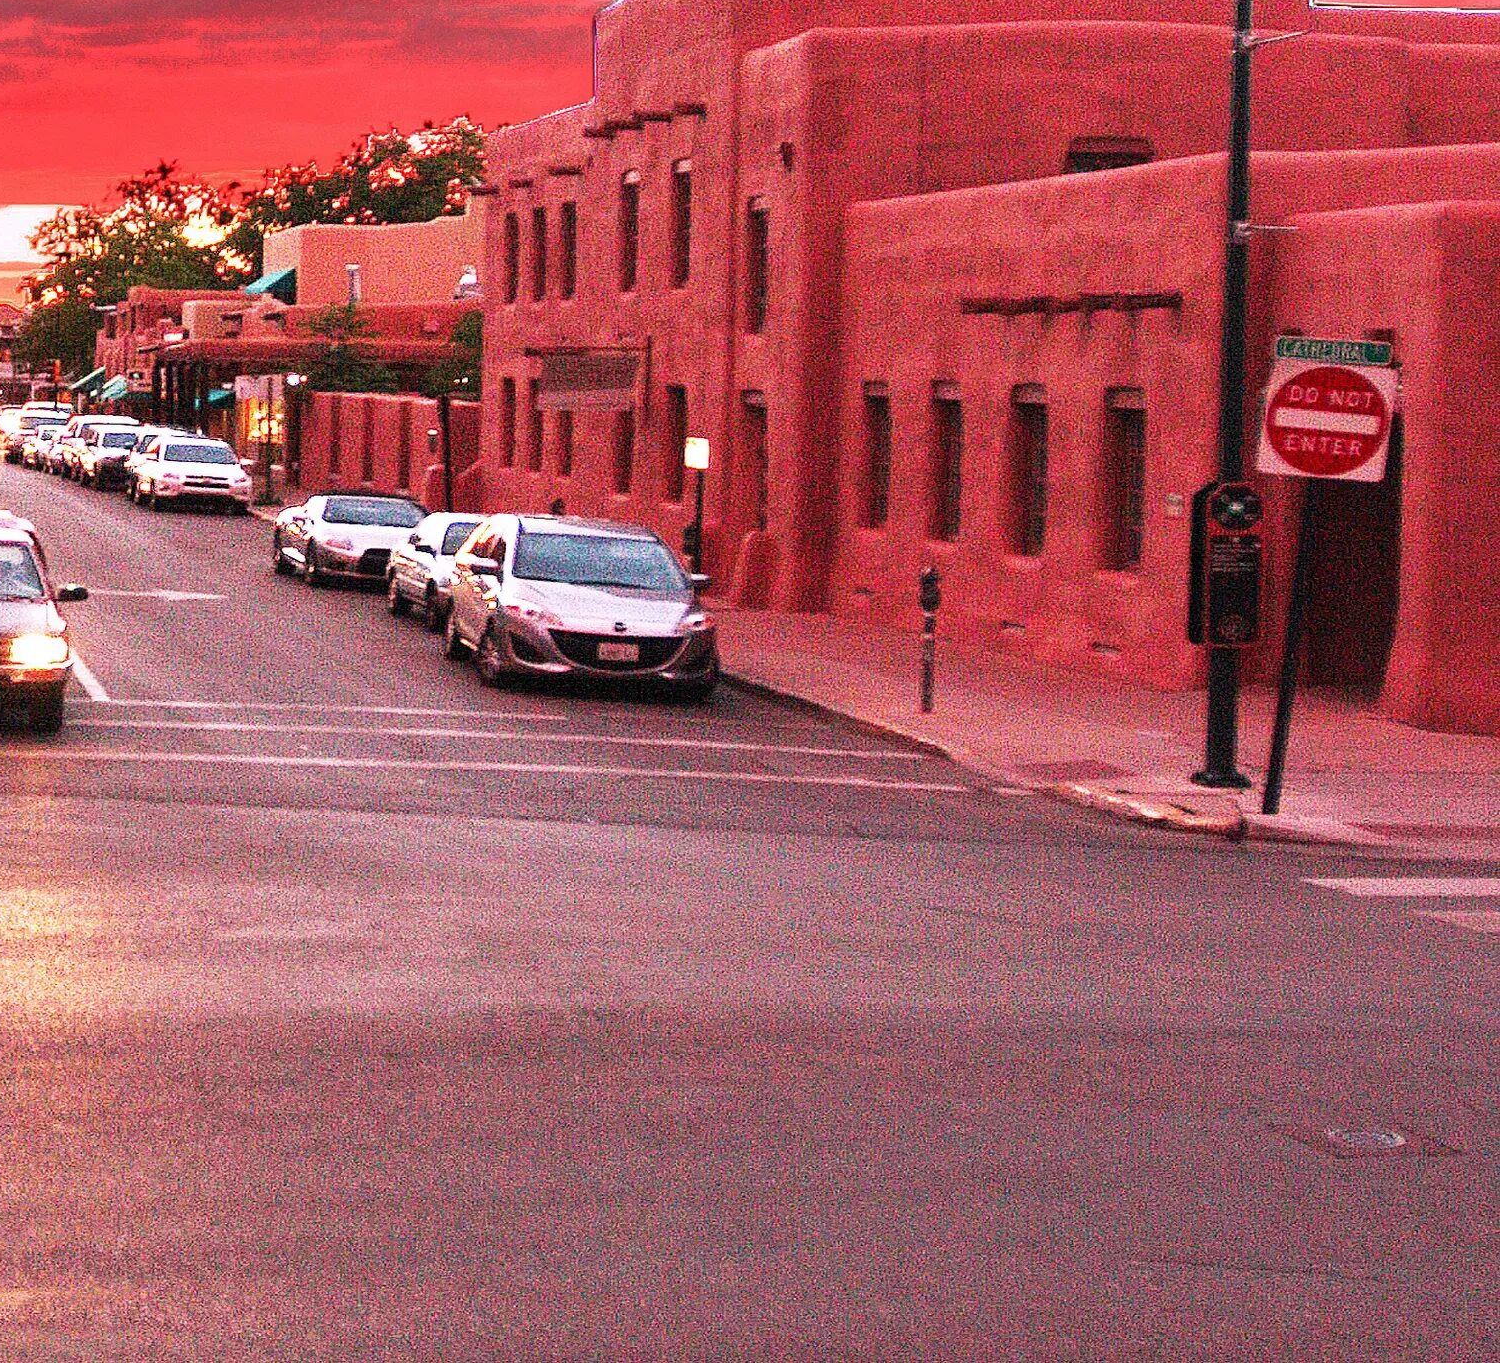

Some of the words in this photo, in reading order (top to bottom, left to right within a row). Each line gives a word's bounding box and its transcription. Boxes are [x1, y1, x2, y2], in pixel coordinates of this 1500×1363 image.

[1283, 340, 1367, 363] CATHEDRAL
[1289, 385, 1318, 403] DO
[1330, 390, 1373, 408] NOT
[1286, 435, 1362, 456] ENTER
